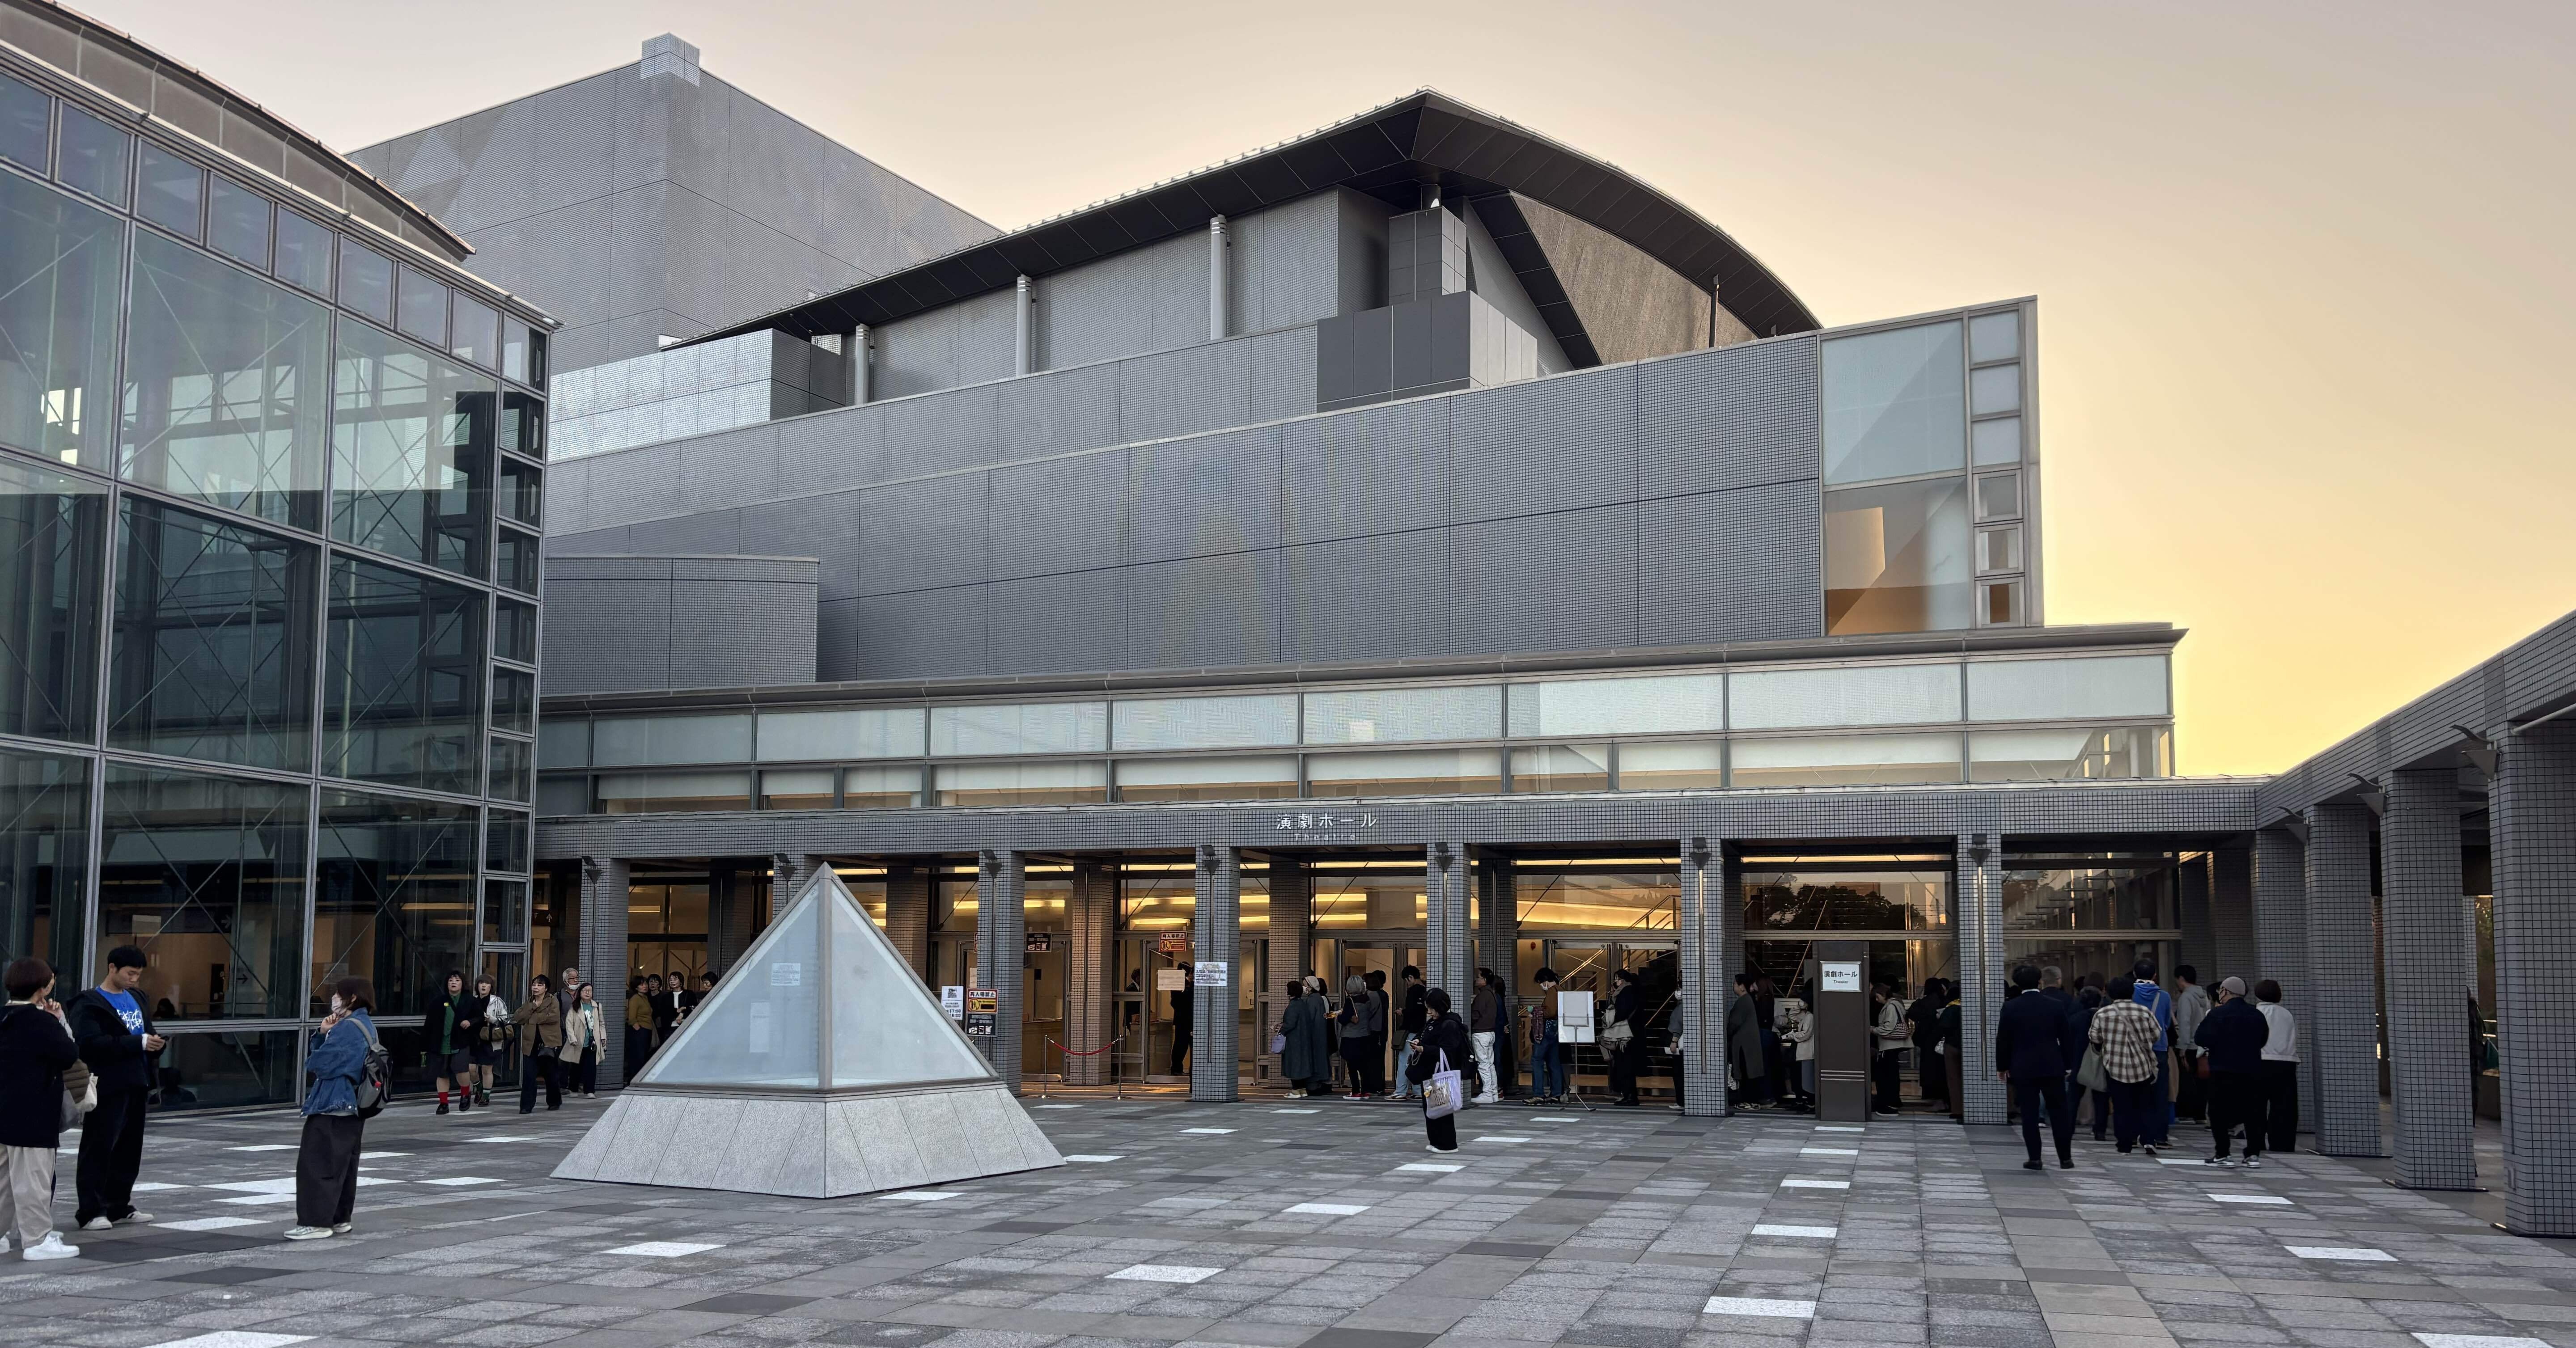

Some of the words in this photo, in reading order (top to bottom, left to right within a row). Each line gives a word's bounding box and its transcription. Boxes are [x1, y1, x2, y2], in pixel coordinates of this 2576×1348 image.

[1276, 813, 1377, 829] 演劇ホール
